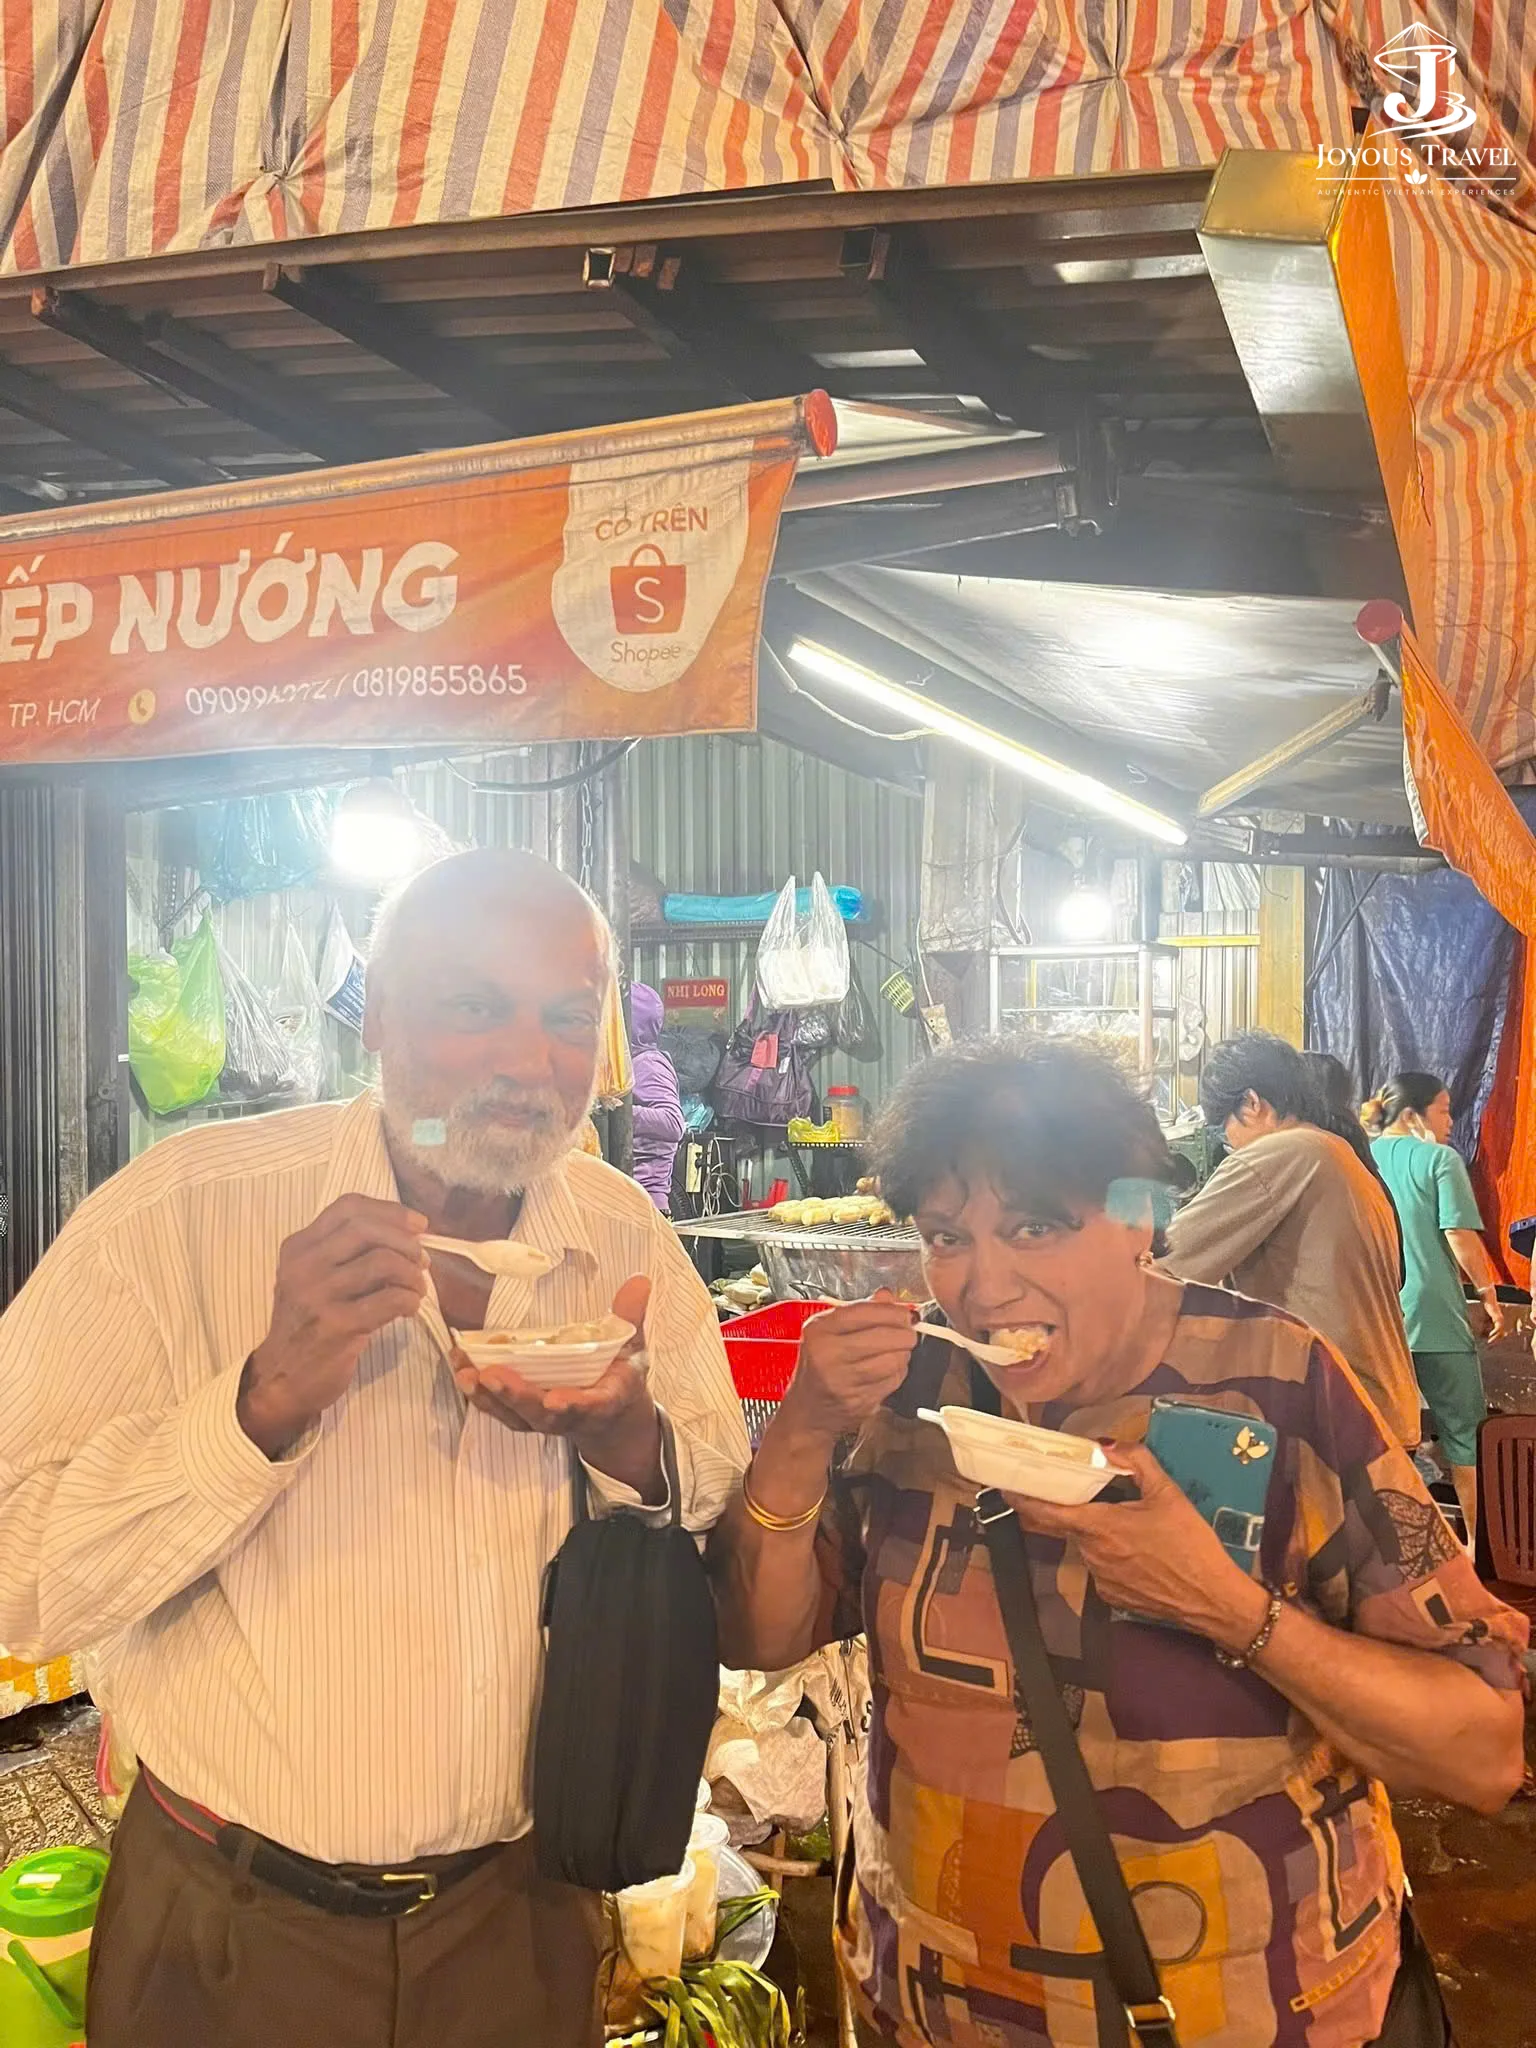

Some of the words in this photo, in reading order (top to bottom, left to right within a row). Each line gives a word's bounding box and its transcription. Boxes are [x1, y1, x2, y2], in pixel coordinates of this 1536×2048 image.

[640, 502, 708, 533] TRÊN
[110, 531, 460, 655] NƯỚNG
[610, 641, 682, 667] Shopee
[9, 702, 40, 728] TP.
[47, 698, 101, 725] HCM
[352, 664, 528, 697] 0819855865
[693, 983, 725, 997] LONG
